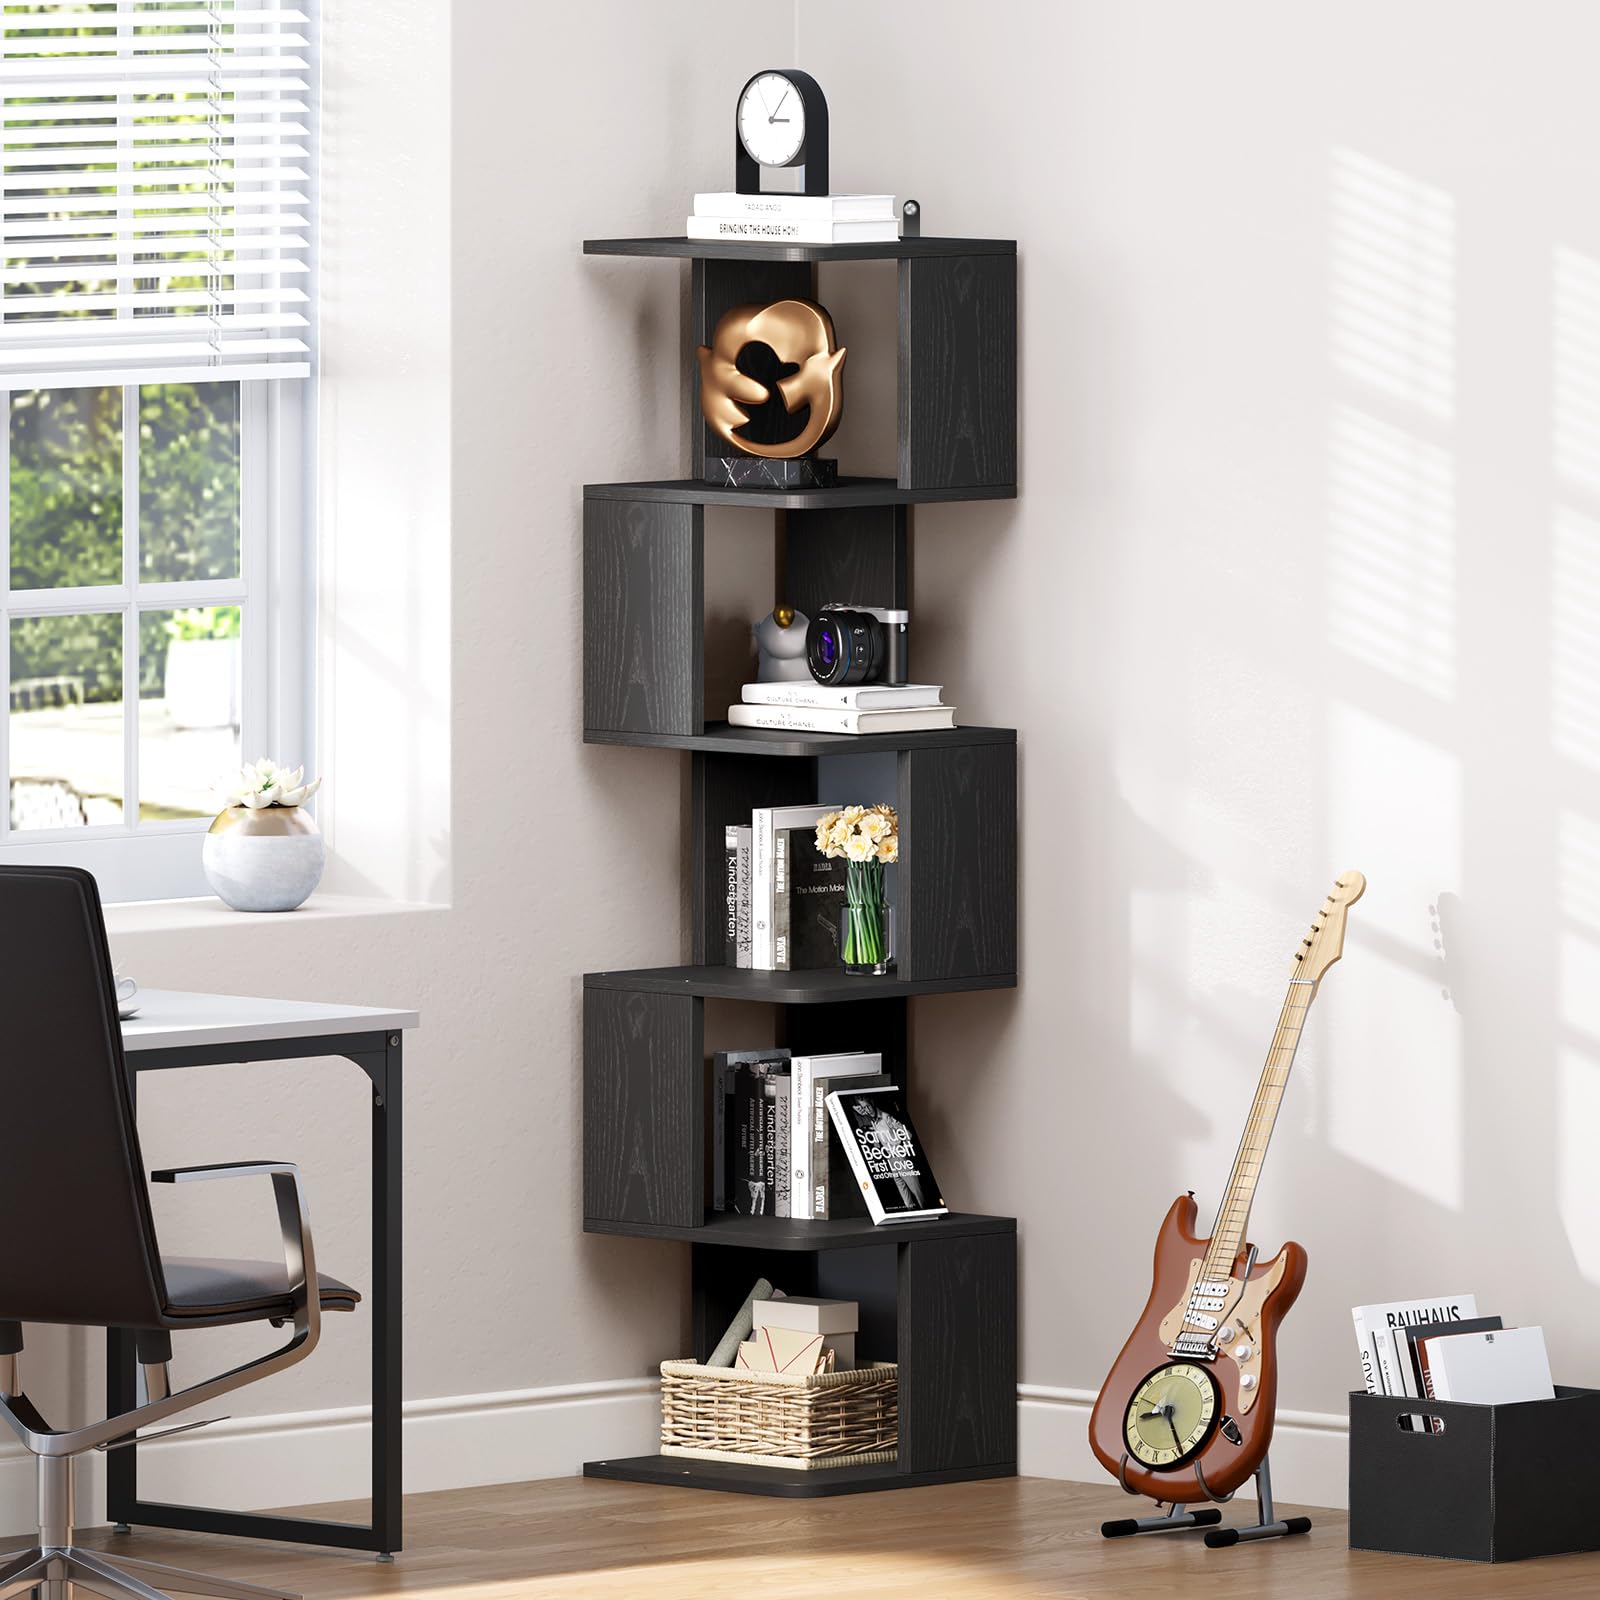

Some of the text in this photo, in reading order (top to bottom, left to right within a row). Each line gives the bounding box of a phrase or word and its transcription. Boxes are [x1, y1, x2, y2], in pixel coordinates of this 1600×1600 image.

[720, 224, 799, 236] BRINGING THE HOUSE HOME
[788, 720, 816, 728] CHANEL
[727, 856, 737, 937] Kindergarten
[796, 886, 807, 894] The
[808, 885, 828, 894] Motion
[856, 1125, 910, 1144] Samuel
[765, 1105, 776, 1186] Kindergarten
[861, 1141, 916, 1161] Beckett
[868, 1159, 914, 1173] First Love
